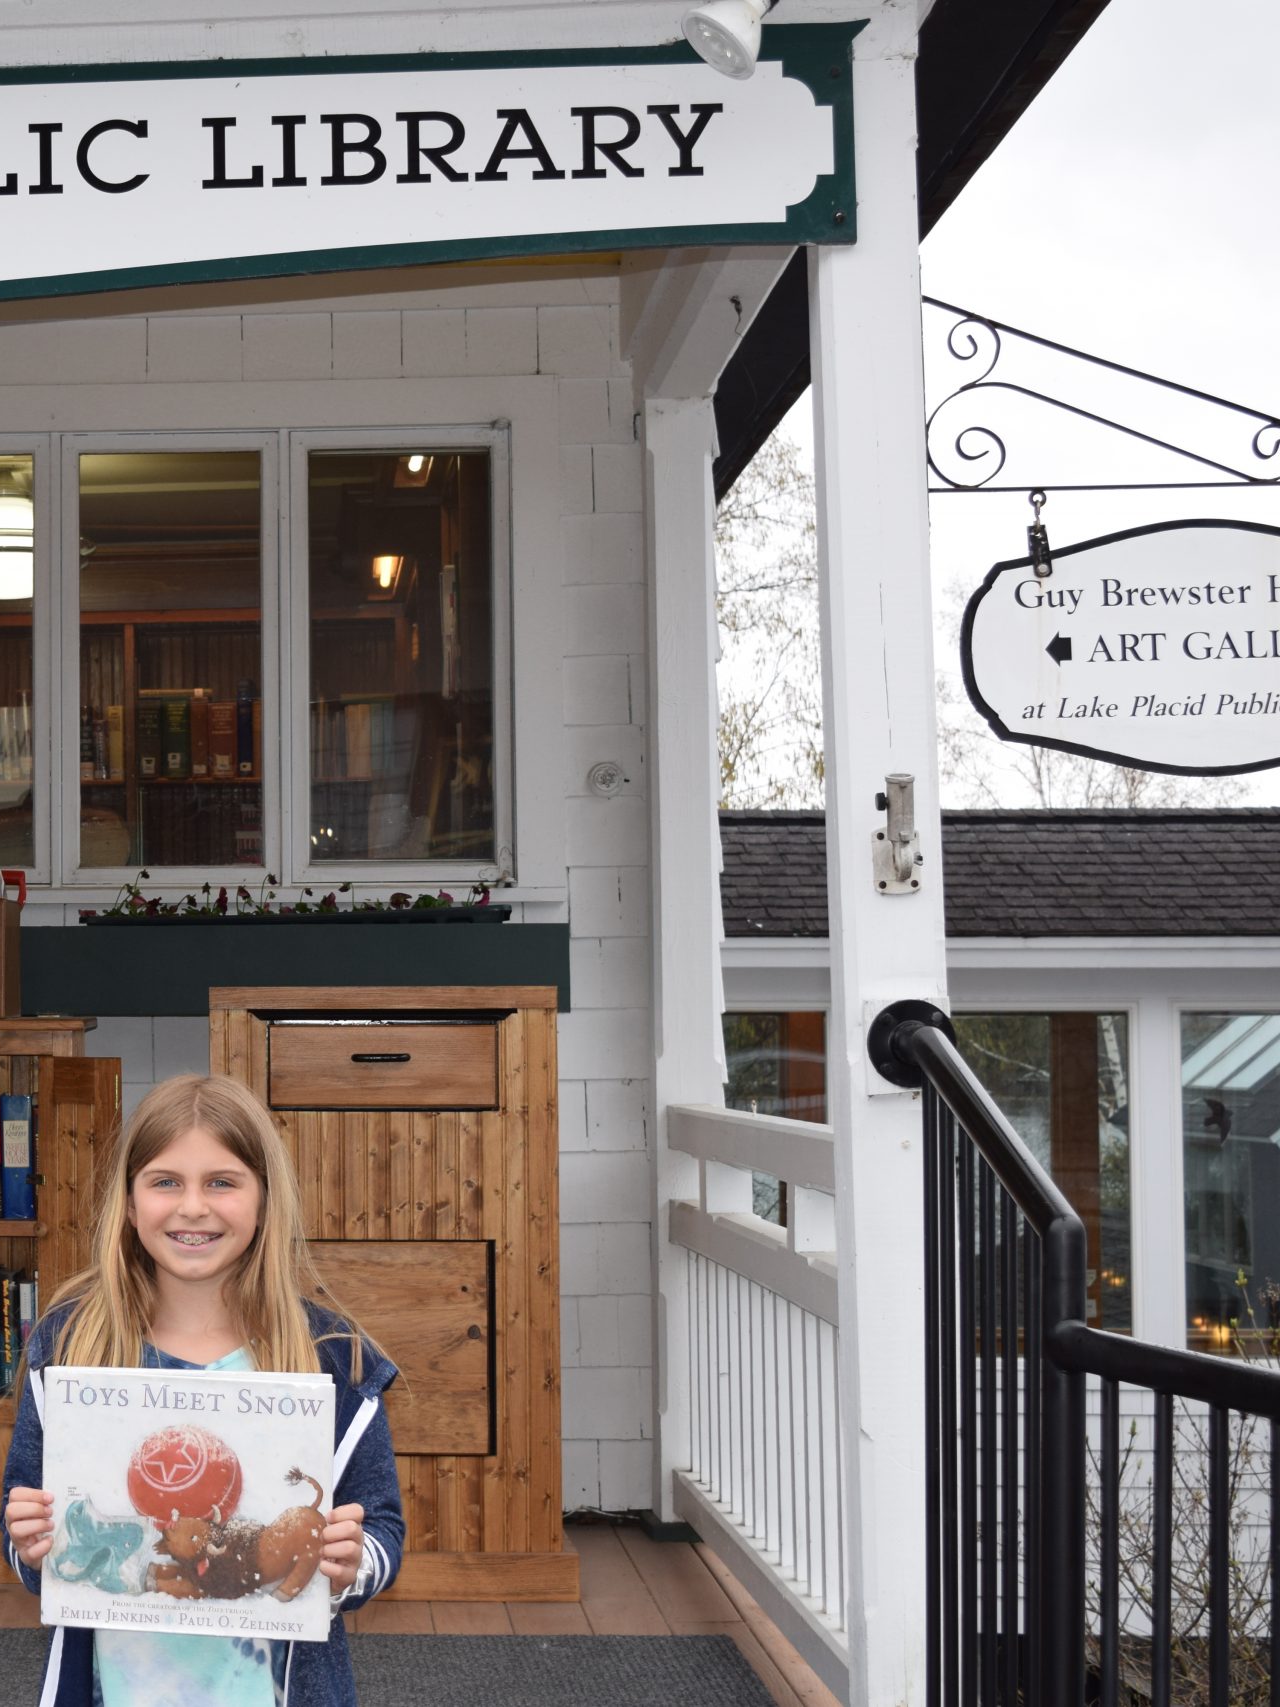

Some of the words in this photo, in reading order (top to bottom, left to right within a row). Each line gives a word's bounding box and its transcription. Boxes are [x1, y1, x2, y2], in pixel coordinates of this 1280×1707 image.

[202, 102, 724, 190] LIBRARY
[1014, 580, 1084, 615] Guy
[1101, 578, 1251, 607] Brewster
[1087, 632, 1167, 663] ART
[1022, 702, 1046, 720] at
[1057, 695, 1119, 719] Lake
[1130, 693, 1207, 718] Placid
[1215, 692, 1280, 716] Publi
[60, 1606, 102, 1621] EMILY
[105, 1608, 161, 1624] JENKINS
[179, 1613, 214, 1628] PAUL
[239, 1617, 304, 1633] ZELINSKY
